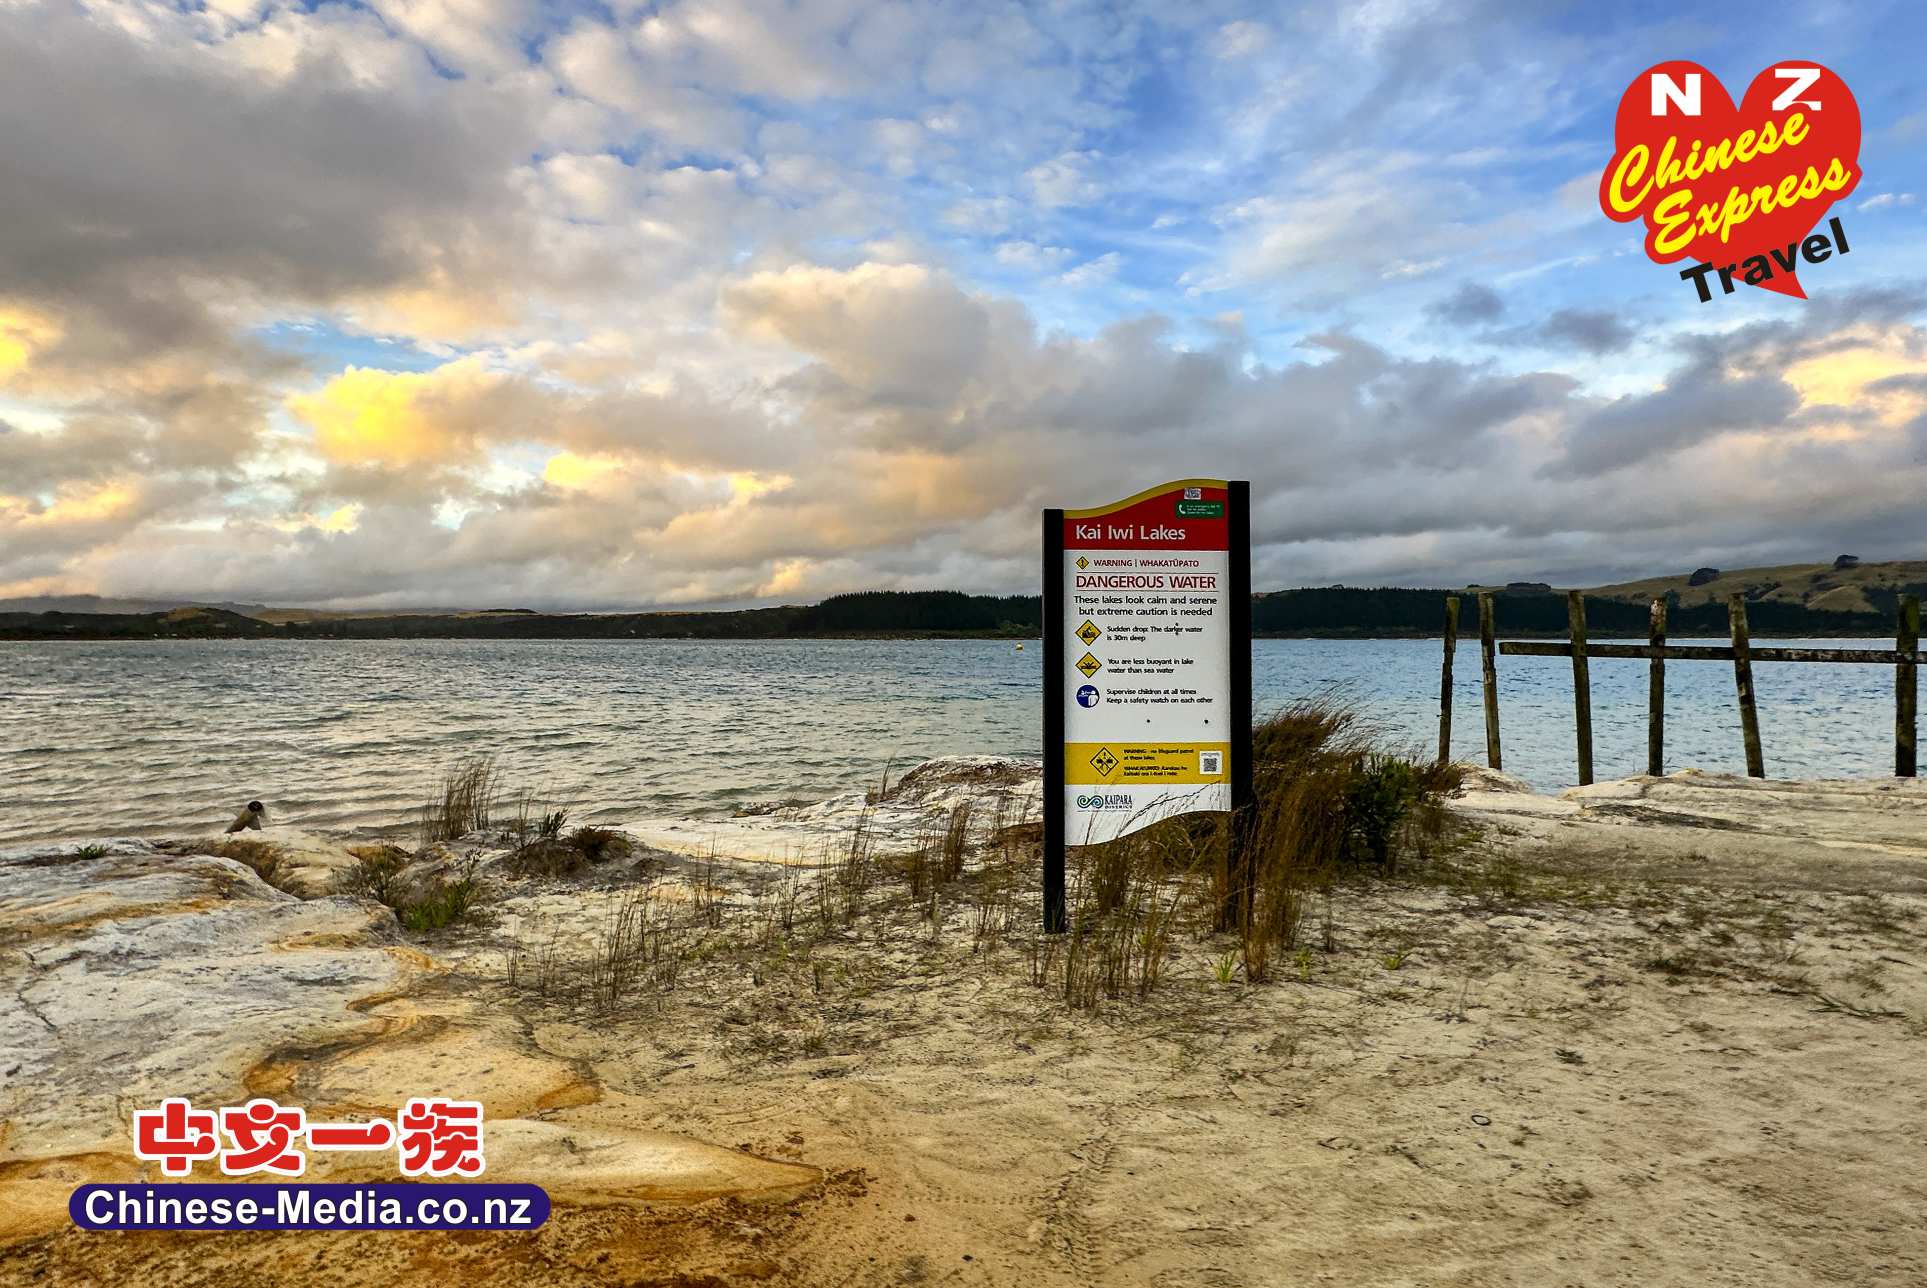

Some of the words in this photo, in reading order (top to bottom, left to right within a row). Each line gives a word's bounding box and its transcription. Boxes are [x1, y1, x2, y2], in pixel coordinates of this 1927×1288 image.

[1076, 524, 1100, 540] Kai
[1108, 524, 1133, 540] Iwi
[1140, 524, 1186, 540] Lakes
[1076, 575, 1164, 588] DANGEROUS
[1169, 576, 1216, 588] WATER
[1074, 596, 1101, 604] These
[1102, 596, 1123, 604] lakes
[1126, 596, 1144, 604] look
[1146, 596, 1168, 604] calm
[1170, 596, 1186, 604] and
[1078, 608, 1094, 616] but
[1136, 608, 1168, 616] caution
[1170, 608, 1178, 616] is
[1180, 608, 1213, 616] needed
[1104, 794, 1132, 805] KAIPARA
